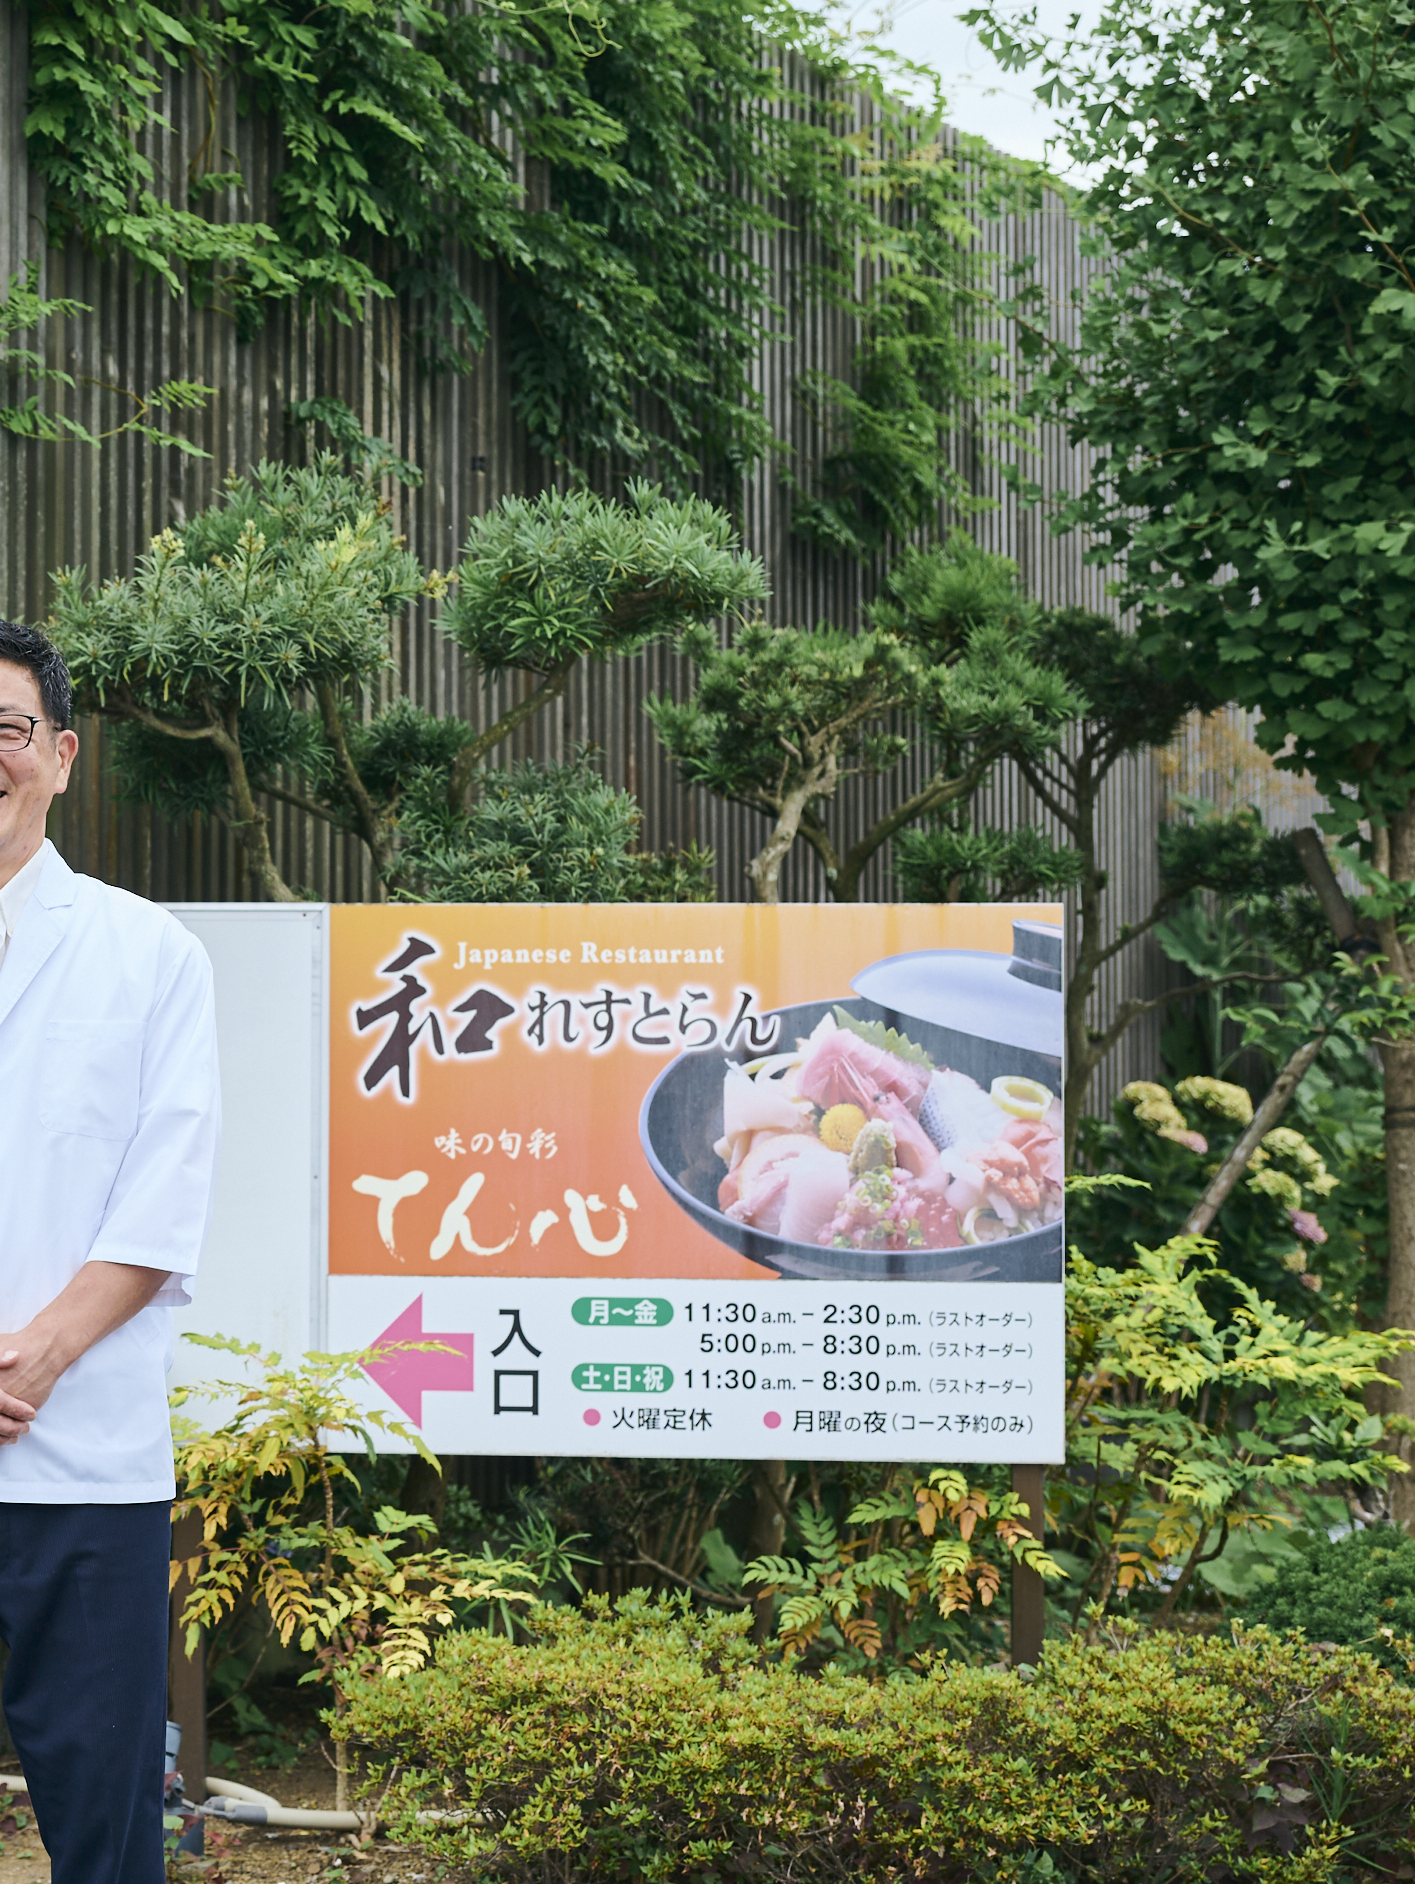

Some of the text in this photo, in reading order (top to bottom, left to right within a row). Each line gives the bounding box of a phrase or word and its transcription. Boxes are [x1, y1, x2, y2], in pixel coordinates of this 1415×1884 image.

[453, 941, 725, 970] Japanese Restaurant
[433, 1127, 559, 1160] 味の旬彩
[684, 1302, 757, 1324] 11:30
[822, 1303, 881, 1325] 2:30
[699, 1332, 757, 1354] 5:00
[822, 1334, 881, 1356] 8:30
[490, 1308, 543, 1417] 入口
[684, 1368, 757, 1390] 11:30
[822, 1370, 881, 1392] 8:30
[611, 1406, 713, 1432] 火曜定休
